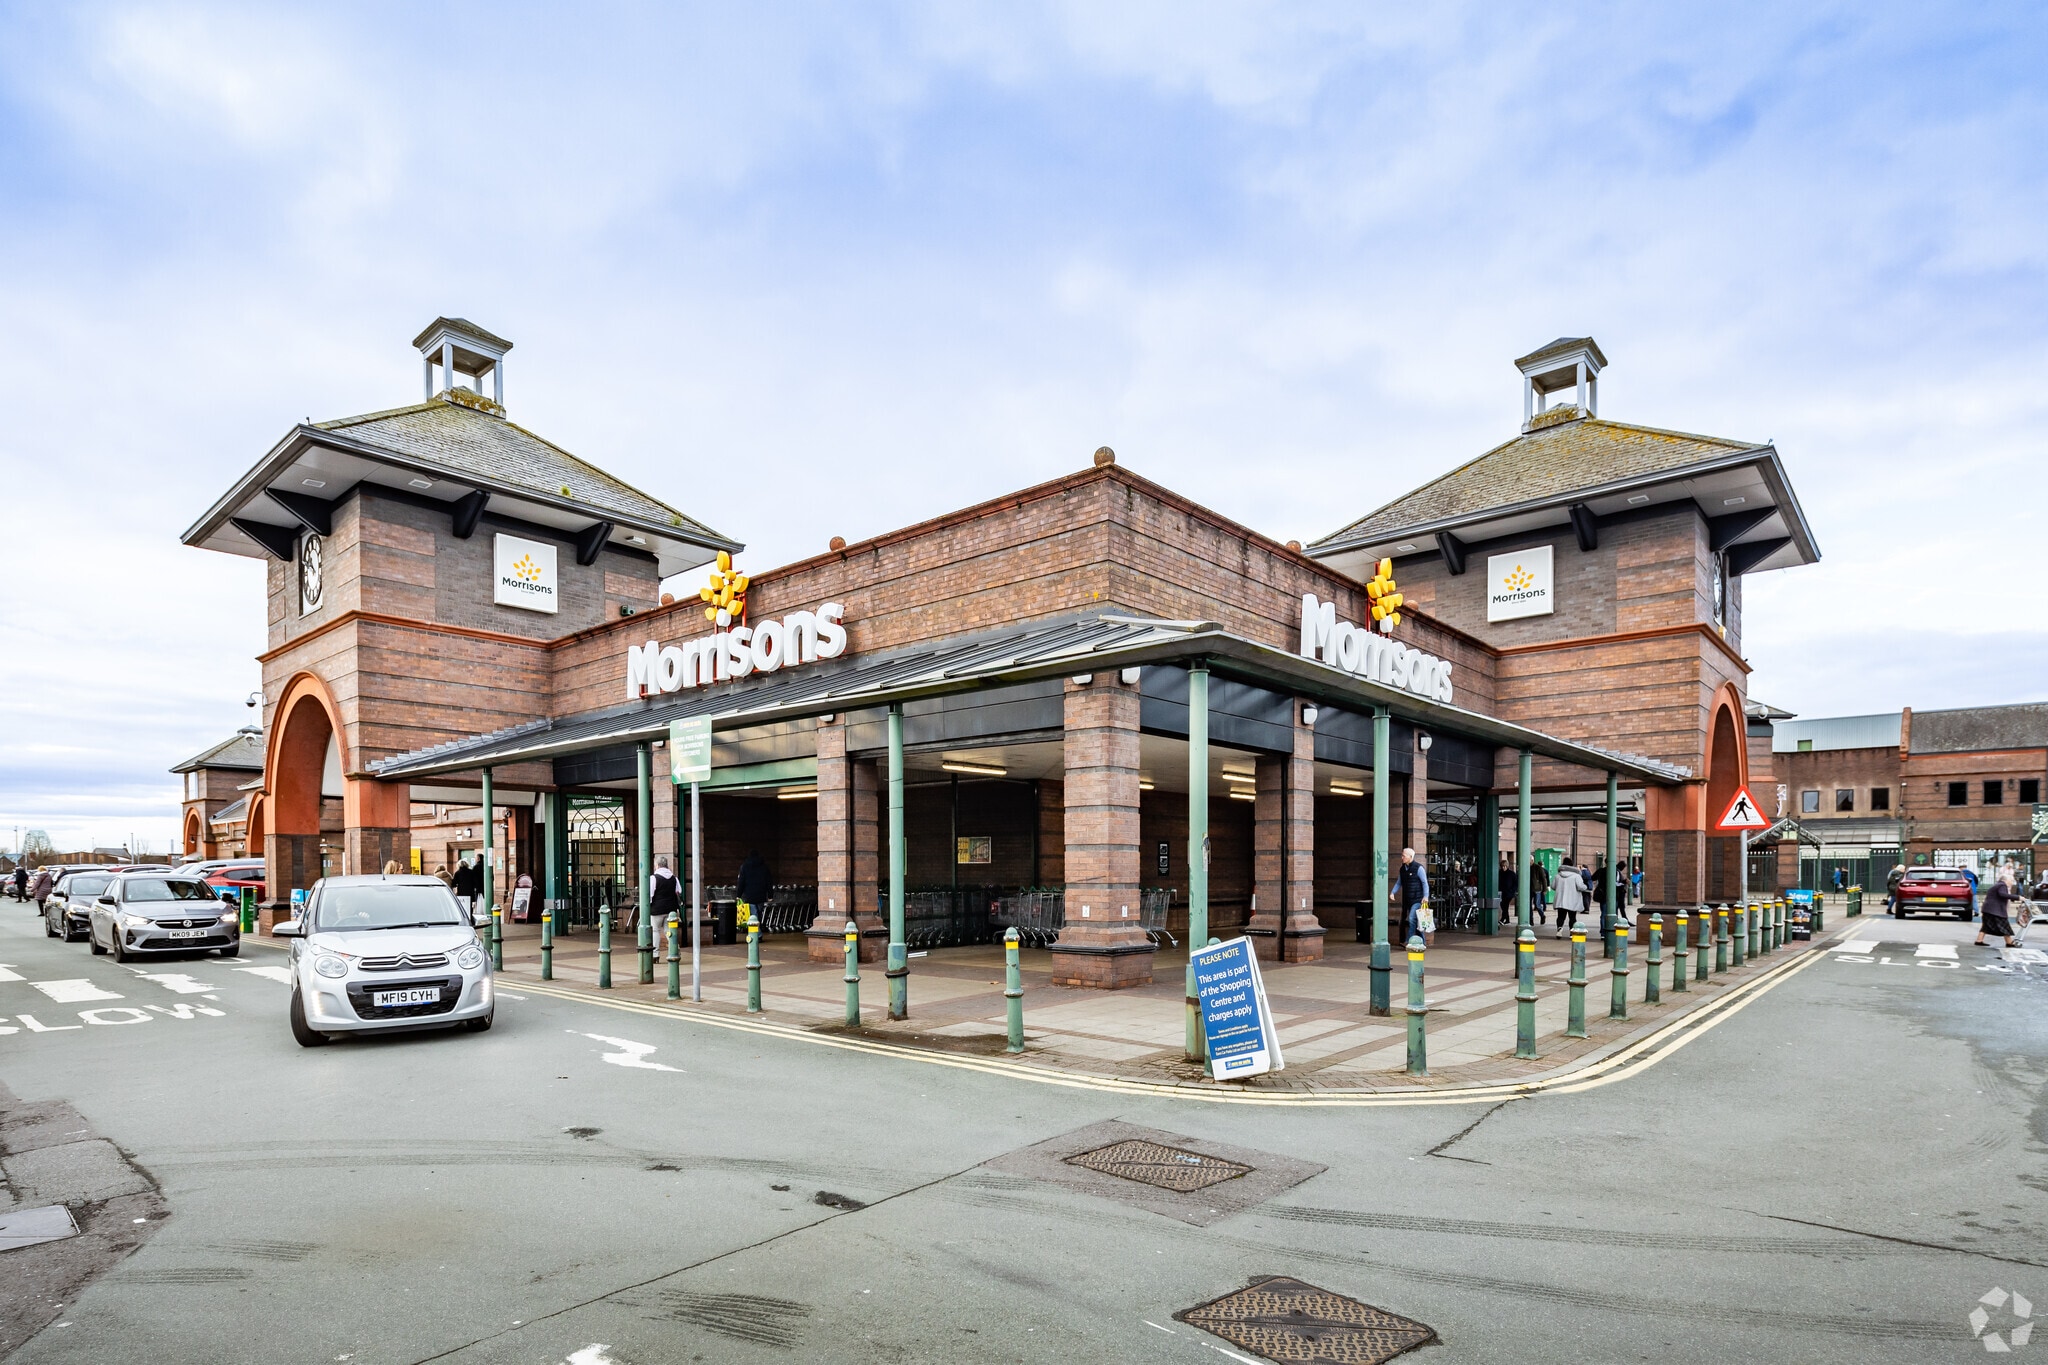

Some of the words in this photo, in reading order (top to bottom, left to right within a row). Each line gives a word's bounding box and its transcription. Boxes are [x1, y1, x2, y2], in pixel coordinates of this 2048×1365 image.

[502, 577, 552, 594] Morrisons
[1492, 588, 1546, 604] Morrisons
[627, 602, 848, 700] Morrisons
[1301, 593, 1453, 704] Morrisons
[1200, 953, 1222, 966] PLEASE
[1222, 948, 1239, 959] NOTE
[1198, 975, 1212, 984] This
[1213, 971, 1227, 980] area
[1228, 968, 1233, 976] is
[1234, 964, 1248, 977] part
[382, 992, 408, 1003] MF19
[411, 990, 432, 1001] CYH
[1201, 988, 1208, 997] of
[1208, 986, 1219, 995] the
[1220, 978, 1252, 991] Shopping
[1211, 997, 1232, 1008] Centre
[1233, 992, 1245, 1004] and
[1209, 1010, 1233, 1022] charges
[1235, 1004, 1252, 1018] apply
